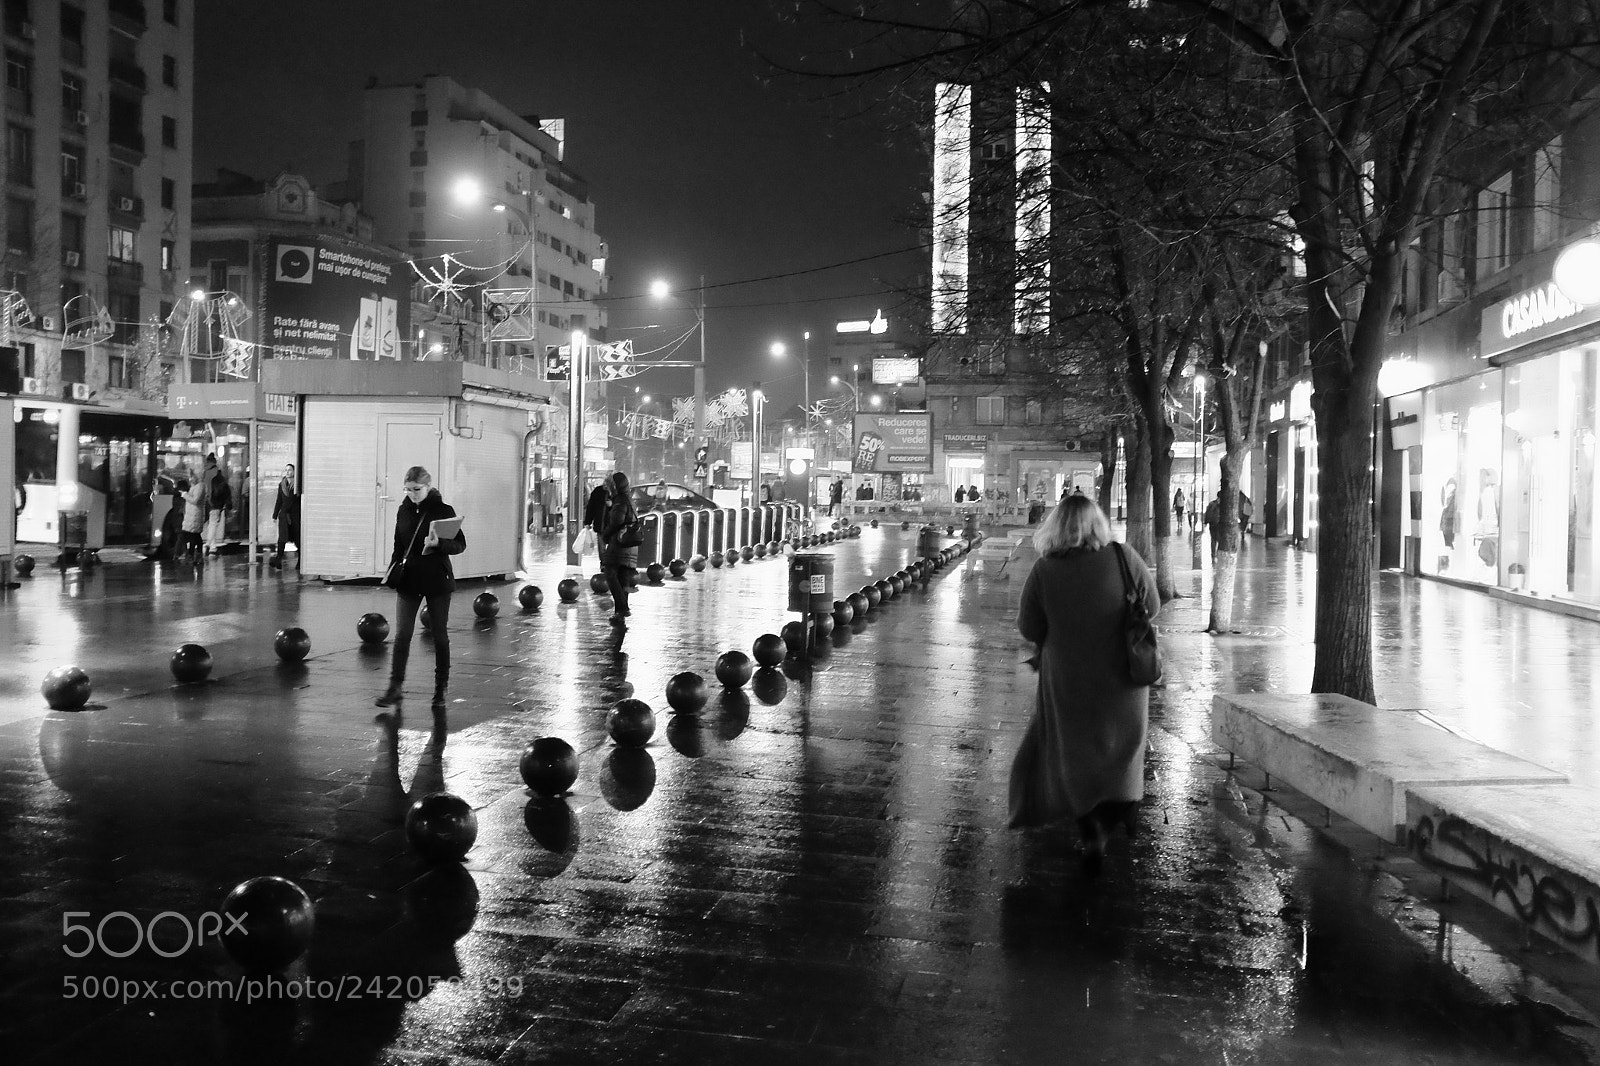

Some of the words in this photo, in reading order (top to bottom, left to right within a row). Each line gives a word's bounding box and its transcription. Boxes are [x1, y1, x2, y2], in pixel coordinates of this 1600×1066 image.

[319, 248, 371, 269] Smartphone-ul
[318, 262, 334, 272] mai
[352, 267, 361, 277] de
[274, 316, 298, 326] Rate
[300, 318, 317, 328] fără
[319, 322, 340, 332] avans
[285, 328, 301, 337] net
[303, 329, 336, 341] nelimitat
[273, 345, 305, 355] pentru
[268, 394, 285, 411] HAI
[878, 418, 927, 427] Reducerea
[860, 435, 885, 453] 50%
[901, 435, 927, 444] vede!
